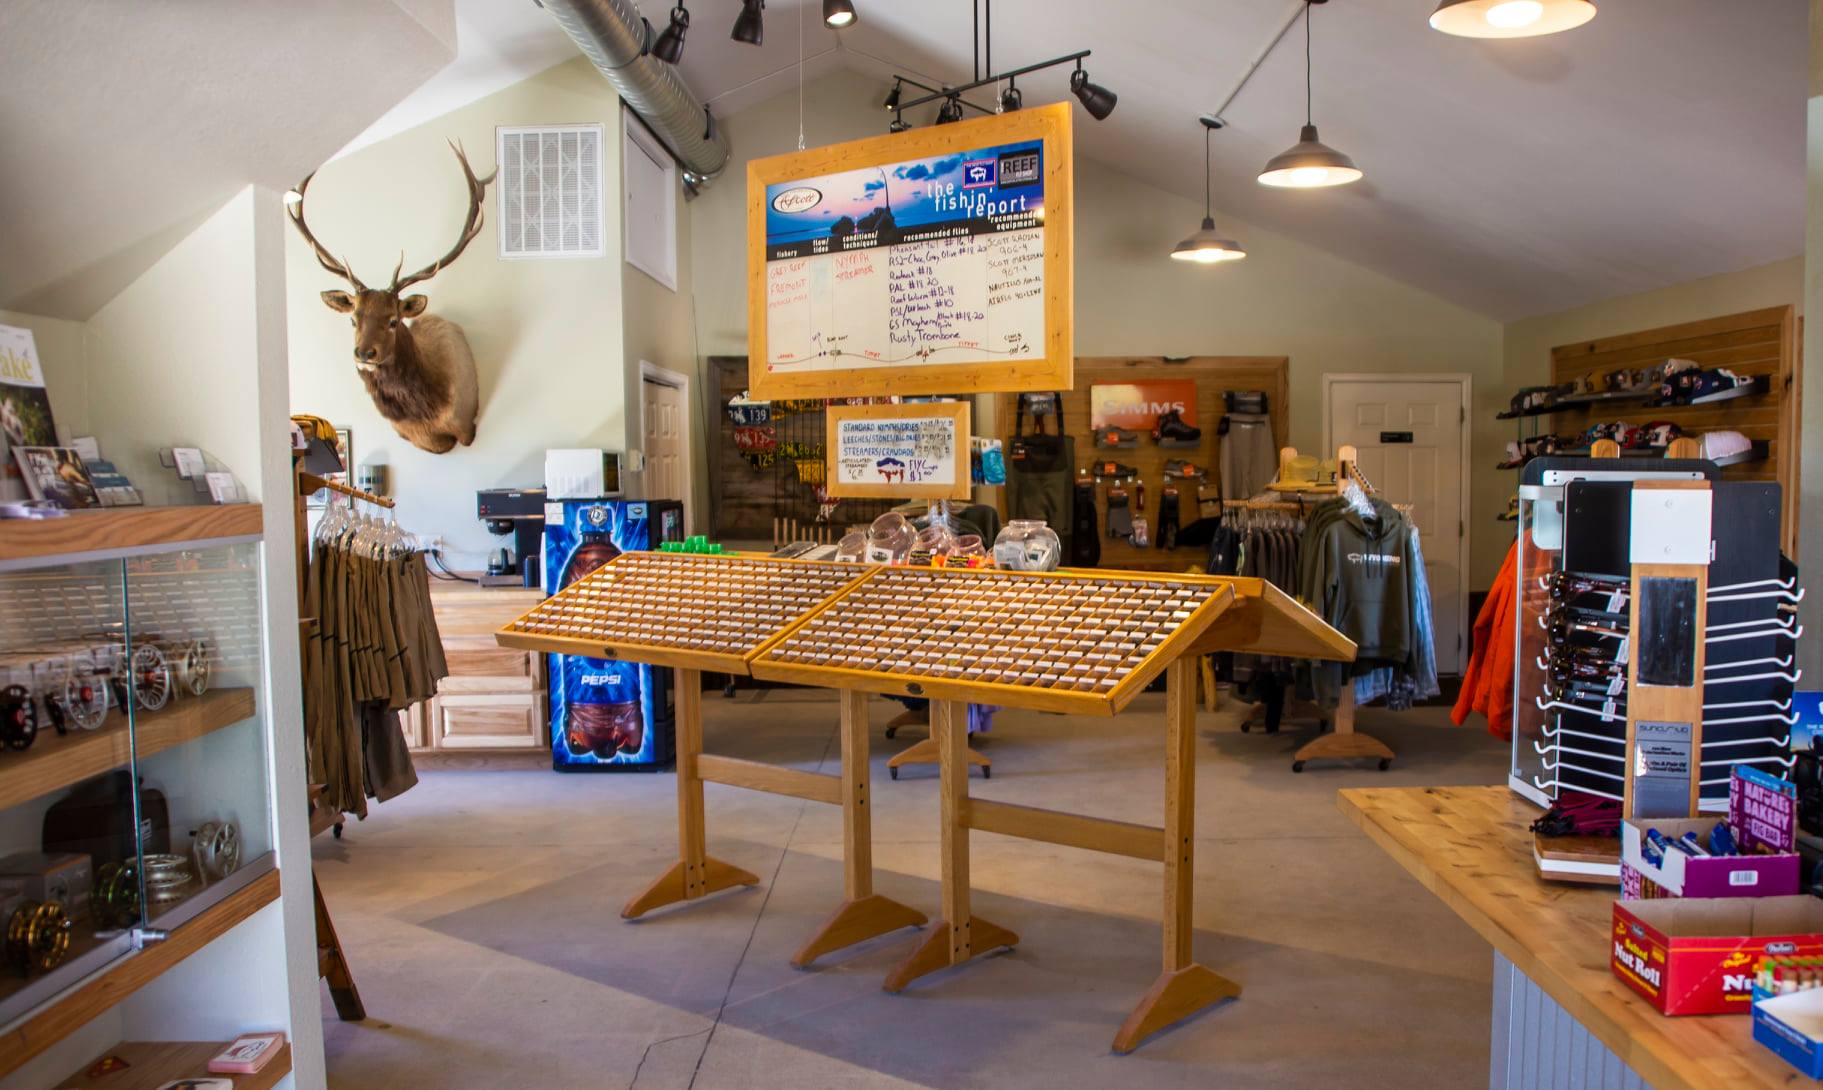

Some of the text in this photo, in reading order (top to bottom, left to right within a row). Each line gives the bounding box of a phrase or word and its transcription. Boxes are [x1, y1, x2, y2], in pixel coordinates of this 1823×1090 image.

[1003, 157, 1037, 174] REEF
[928, 181, 954, 198] the
[967, 195, 1026, 220] report
[996, 219, 1036, 231] equipment
[843, 231, 878, 242] conditions/
[903, 227, 969, 242] recommended flies
[843, 240, 877, 249] techniques
[776, 249, 797, 258] fishery
[890, 328, 960, 347] Rusty Trombone
[1103, 400, 1185, 416] SIMMS
[843, 423, 875, 432] STANDARD
[581, 674, 621, 685] PEPSI
[1744, 798, 1789, 831] BAKERY
[1754, 821, 1764, 836] FIG
[1765, 827, 1778, 842] BAR
[1614, 940, 1634, 968] Nut
[1635, 956, 1660, 988] Roll
